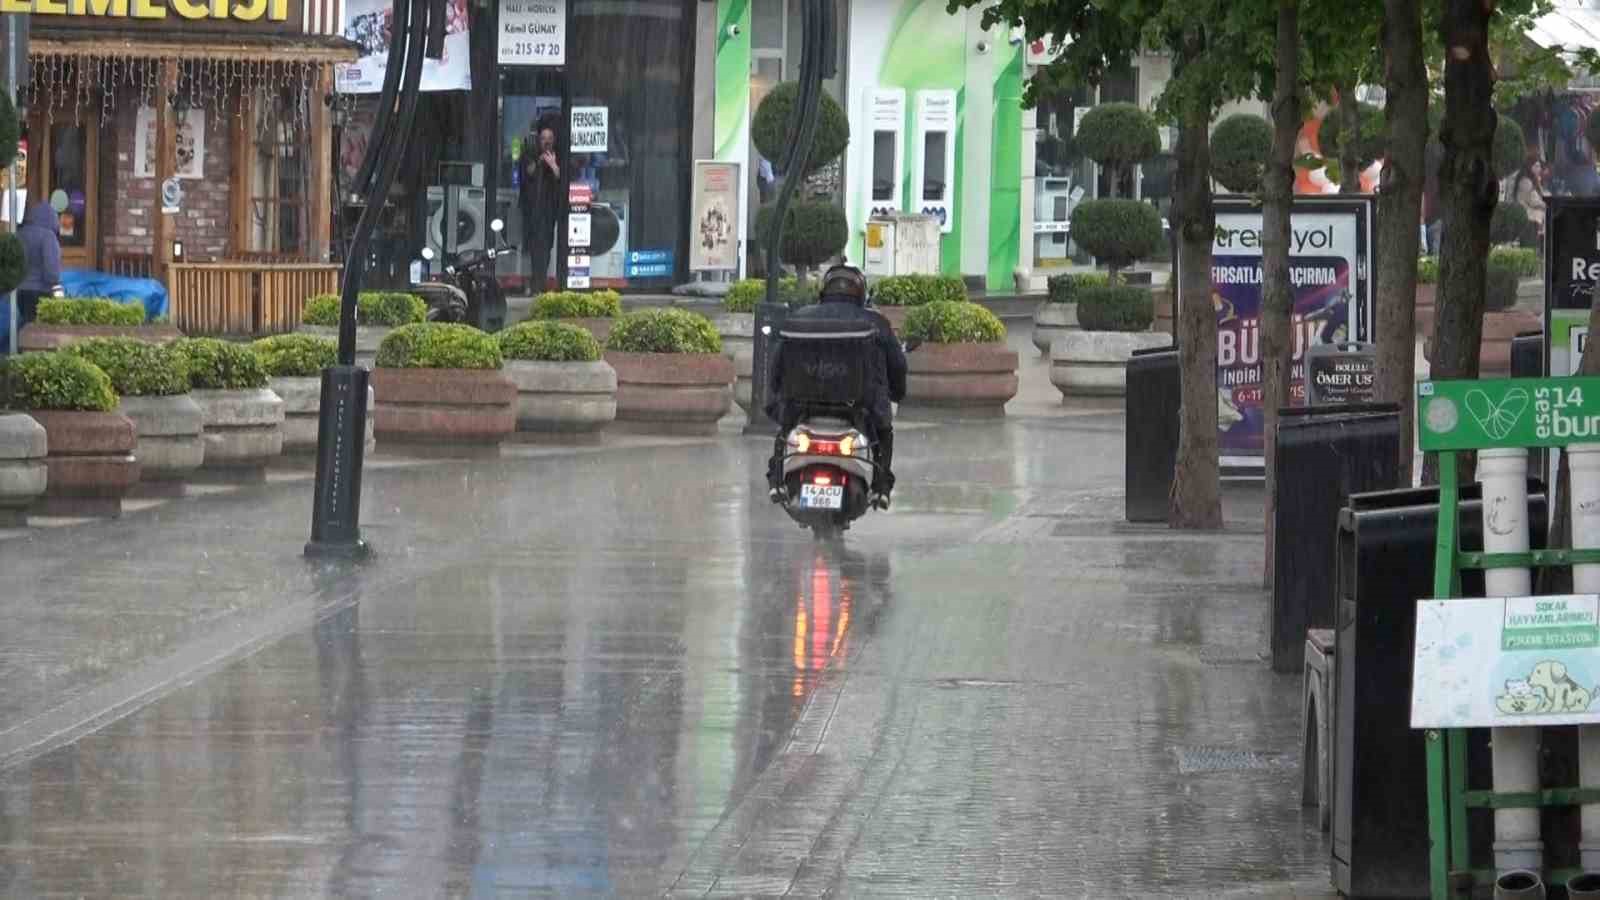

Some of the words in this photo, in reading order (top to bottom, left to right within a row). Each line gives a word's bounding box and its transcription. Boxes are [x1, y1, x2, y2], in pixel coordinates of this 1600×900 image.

[516, 43, 532, 55] 215
[534, 43, 545, 55] 47
[548, 43, 560, 55] 20
[573, 112, 604, 127] PERSONEL
[1216, 224, 1333, 252] treyol
[1211, 266, 1263, 284] FIRSATLA
[1316, 370, 1351, 384] ÖMER
[1552, 386, 1584, 408] 14
[1536, 601, 1568, 611] SOKAK
